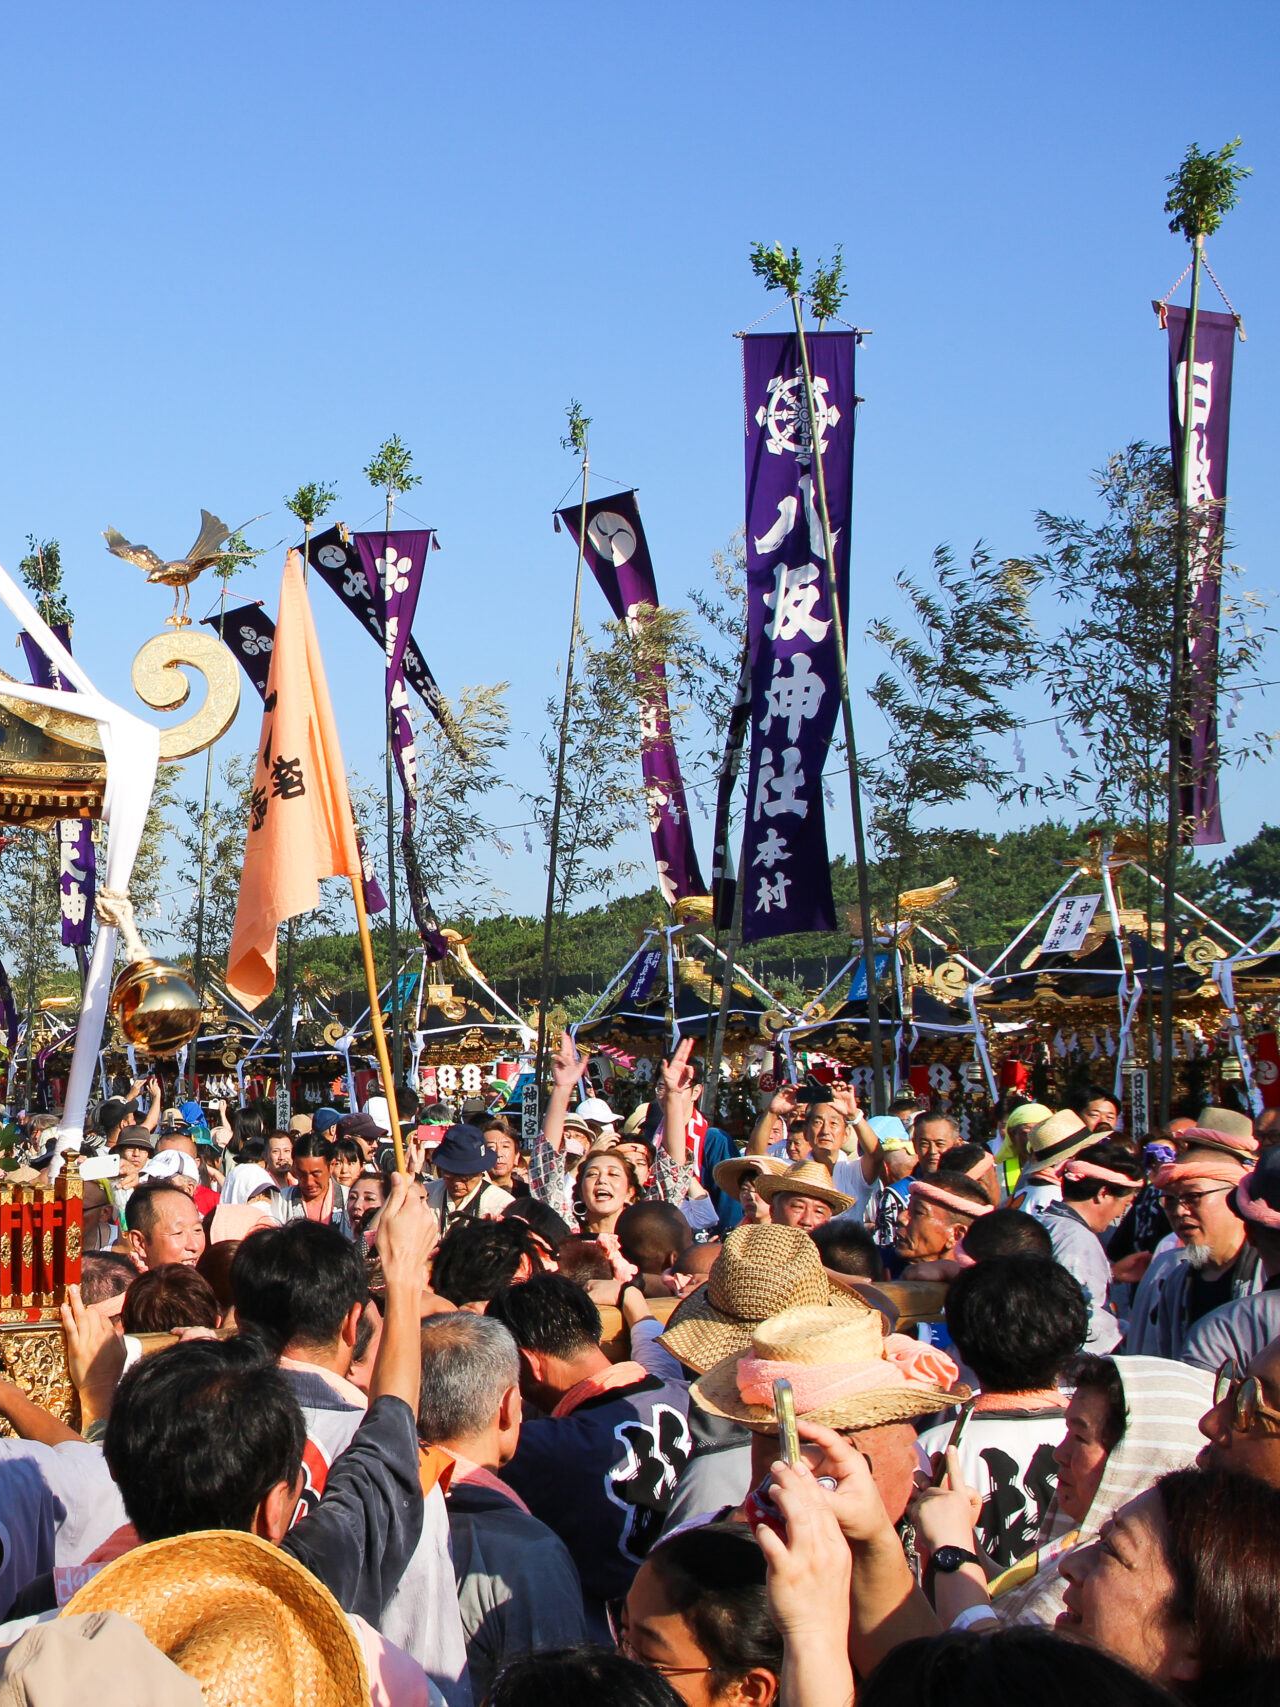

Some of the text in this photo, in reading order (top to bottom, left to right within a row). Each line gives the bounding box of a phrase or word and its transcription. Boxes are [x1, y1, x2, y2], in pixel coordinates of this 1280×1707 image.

[1045, 900, 1076, 951] 日枝神社
[1071, 902, 1092, 936] 中島
[523, 1086, 538, 1136] 神明宮
